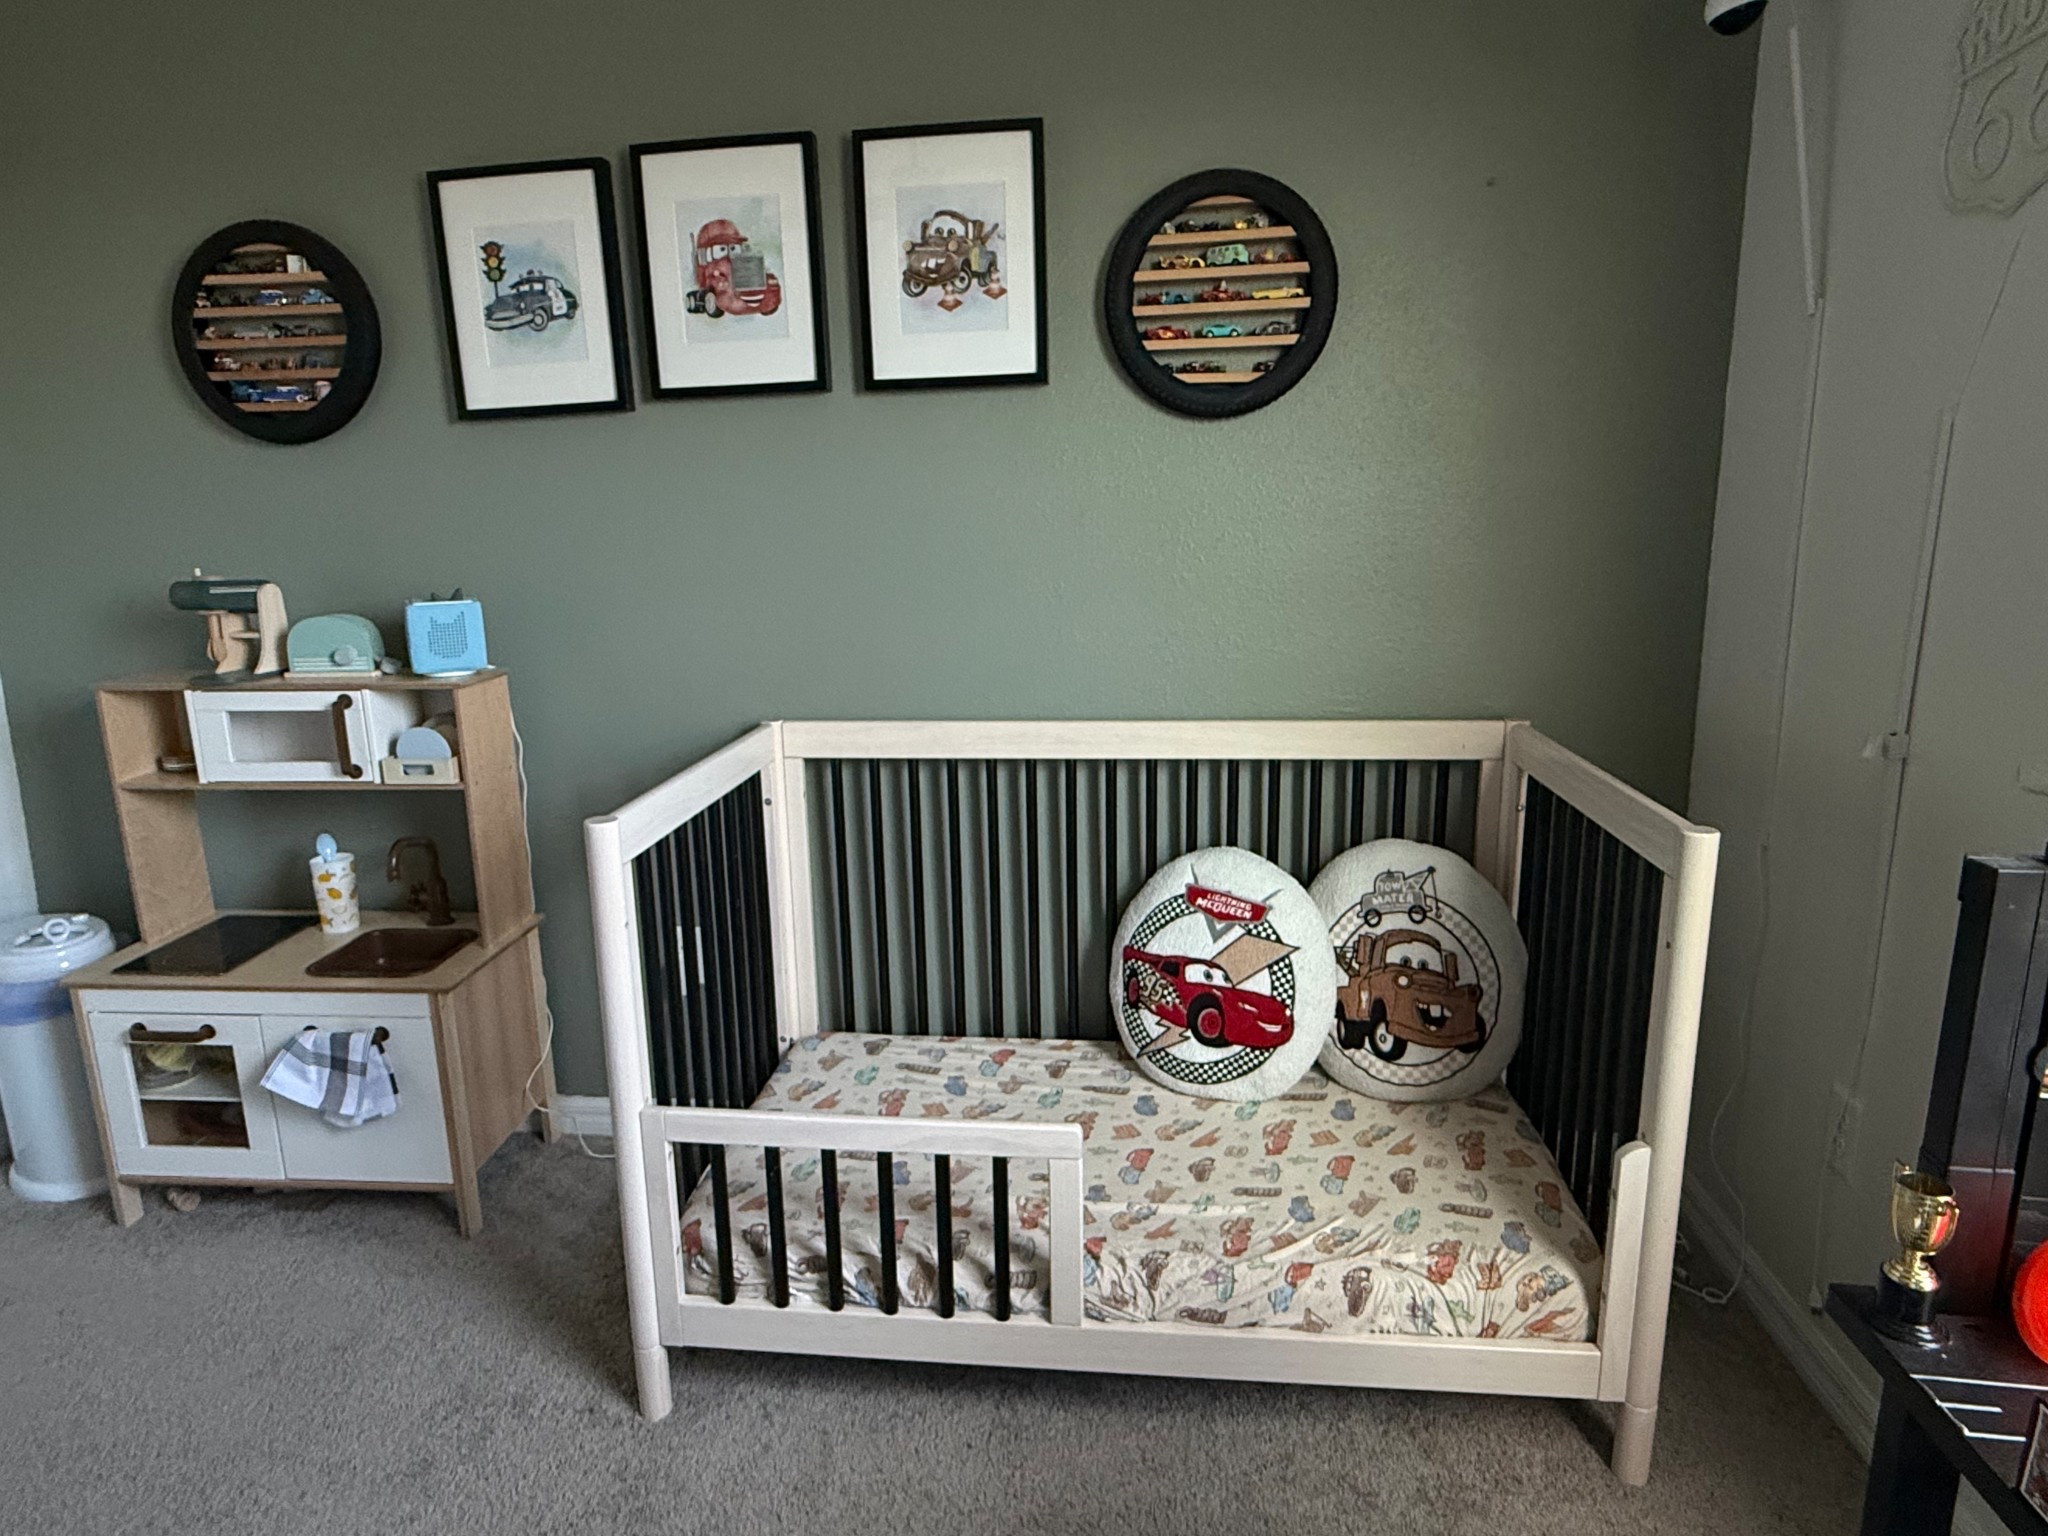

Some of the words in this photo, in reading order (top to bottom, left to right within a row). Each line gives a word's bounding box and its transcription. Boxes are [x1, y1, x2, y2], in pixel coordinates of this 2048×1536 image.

[1195, 897, 1253, 919] MCQUEEN
[1207, 893, 1253, 911] LIGHTNING
[1140, 975, 1167, 1001] 95
